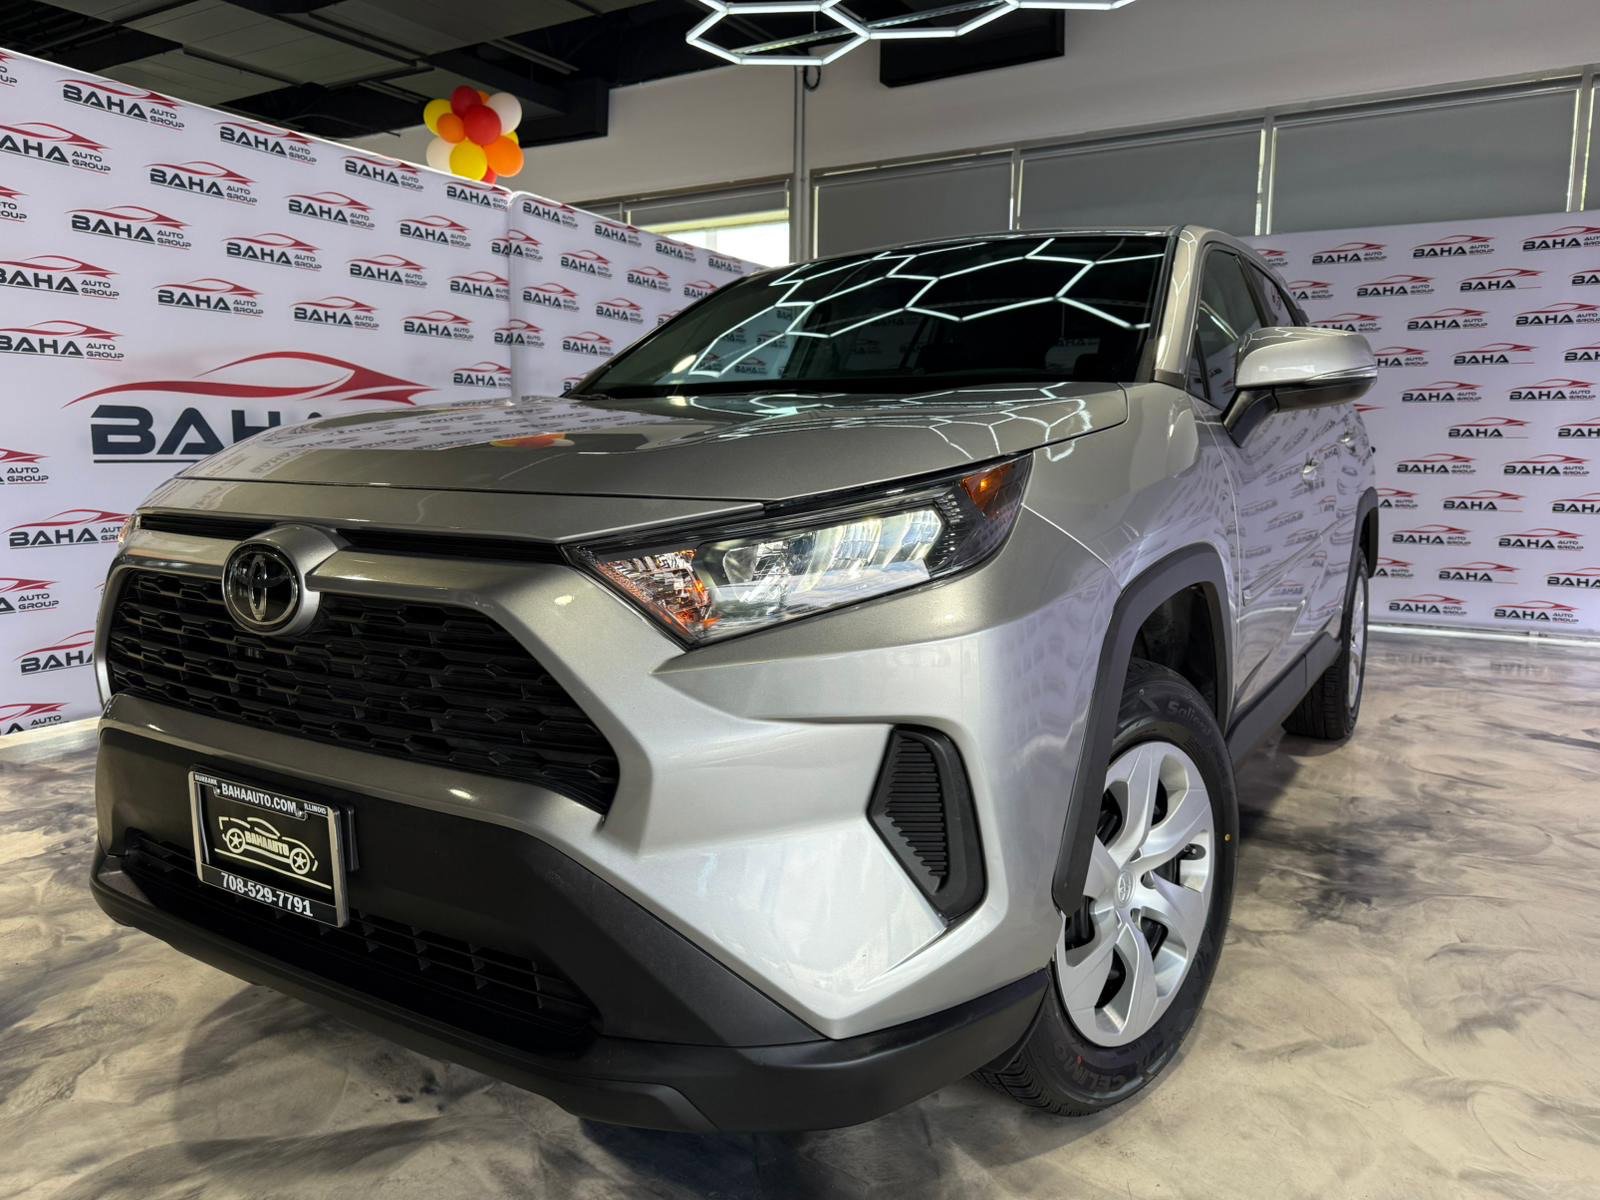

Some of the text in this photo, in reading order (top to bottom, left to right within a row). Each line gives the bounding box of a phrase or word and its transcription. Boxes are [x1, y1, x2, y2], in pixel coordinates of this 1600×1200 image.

[63, 84, 148, 121] BAHA
[150, 108, 177, 119] AUTO
[149, 115, 185, 129] GROUP
[220, 126, 287, 156] BAHA
[0, 134, 70, 164] AHA
[71, 150, 103, 163] AUTO
[288, 152, 317, 163] GROUP
[72, 159, 111, 172] GROUP
[345, 160, 400, 185] BAHA
[150, 168, 225, 197] BAHA
[226, 185, 251, 195] AUTO
[226, 193, 258, 204] GROUP
[447, 185, 491, 207] BAHA
[288, 199, 348, 223] BAHA
[523, 201, 561, 223] BAHA
[71, 214, 156, 242] BAHA
[350, 219, 375, 229] GROUP
[157, 229, 184, 239] AUTO
[400, 223, 449, 244] BAHA
[595, 224, 627, 244] BAHA
[157, 237, 192, 248] GROUP
[1523, 238, 1581, 250] BAHA
[226, 242, 293, 266] BAHA
[1413, 247, 1467, 258] BAHA
[1312, 253, 1362, 264] BAHA
[294, 260, 322, 270] GROUP
[561, 256, 596, 274] BAHA
[350, 263, 404, 284] BAHA
[81, 279, 111, 288] AUTO
[627, 273, 657, 290] BAHA
[1460, 280, 1516, 291] BAHA
[81, 288, 119, 298] GROUP
[449, 280, 495, 298] BAHA
[1357, 286, 1408, 297] BAHA
[158, 290, 232, 312] BAHA
[233, 299, 257, 308] AUTO
[523, 291, 561, 309] BAHA
[233, 307, 264, 315] GROUP
[294, 307, 354, 326] BAHA
[596, 305, 628, 321] BAHA
[1407, 320, 1461, 330] BAHA
[1516, 314, 1574, 325] BAHA
[354, 321, 380, 330] GROUP
[404, 321, 453, 337] BAHA
[562, 340, 597, 354] BAHA
[87, 351, 124, 359] GROUP
[1454, 355, 1509, 365] BAHA
[454, 373, 497, 386] BAHA
[1402, 392, 1455, 402] BAHA
[1510, 390, 1567, 400] BAHA
[90, 404, 322, 455] BAH
[1448, 428, 1503, 438] BAHA
[1558, 427, 1600, 437] BAH
[1397, 463, 1449, 473] BAHA
[1504, 465, 1560, 475] BAHA
[1444, 501, 1497, 511] BAHA
[1552, 503, 1600, 513] BAH
[9, 527, 98, 547] BAHA
[1392, 535, 1444, 544] BAHA
[1499, 538, 1555, 548] BAHA
[1439, 571, 1493, 581] BAHA
[18, 593, 50, 602] AUTO
[18, 600, 59, 609] GROUP
[1389, 603, 1440, 613] BAHA
[1494, 609, 1550, 620] BAHA
[30, 715, 62, 726] AUTO
[222, 783, 296, 814] BAHAAUTO.COM
[304, 803, 327, 814] ILLINOIS
[244, 831, 290, 856] BAHAAUTO
[221, 872, 313, 916] 708-529-7791
